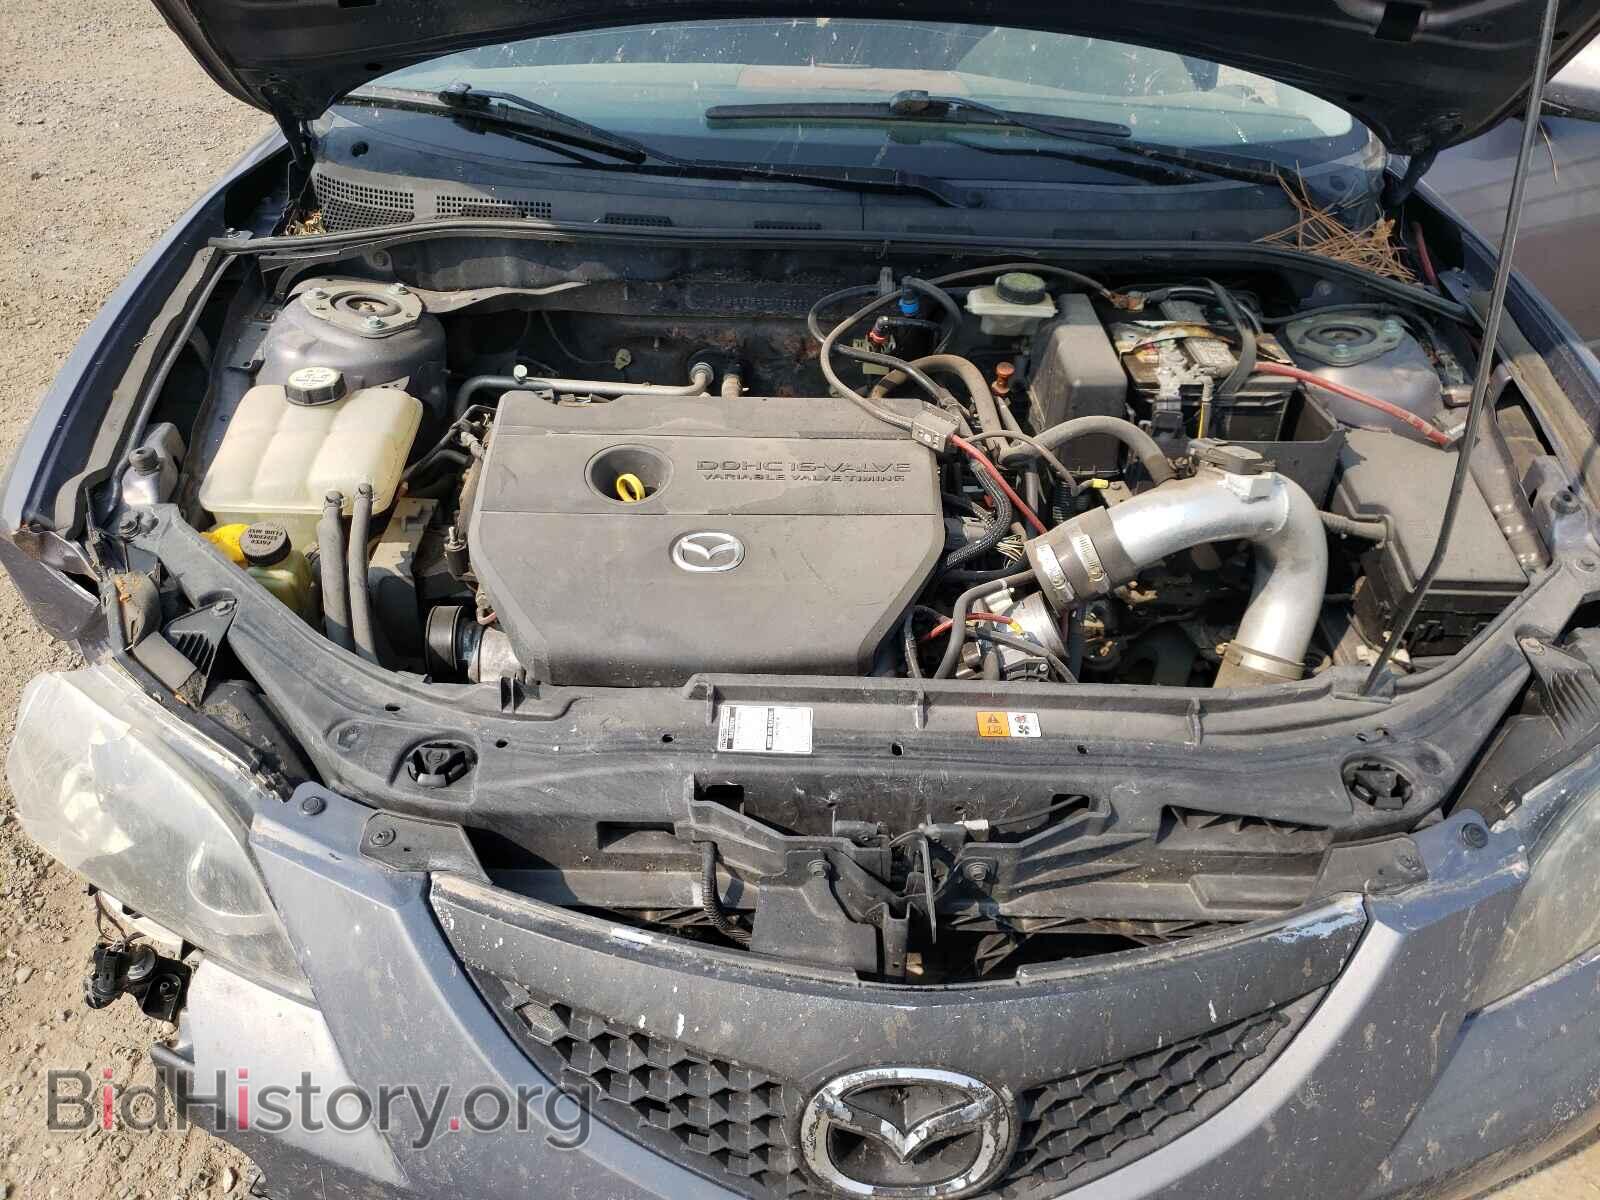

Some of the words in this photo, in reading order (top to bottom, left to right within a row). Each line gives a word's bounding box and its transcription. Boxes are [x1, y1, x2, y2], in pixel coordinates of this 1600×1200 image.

[695, 460, 783, 472] DOHC
[790, 461, 912, 473] 16-VALVE
[702, 472, 786, 481] VARIABLE
[791, 474, 843, 482] VALVE
[848, 474, 905, 482] TIMING
